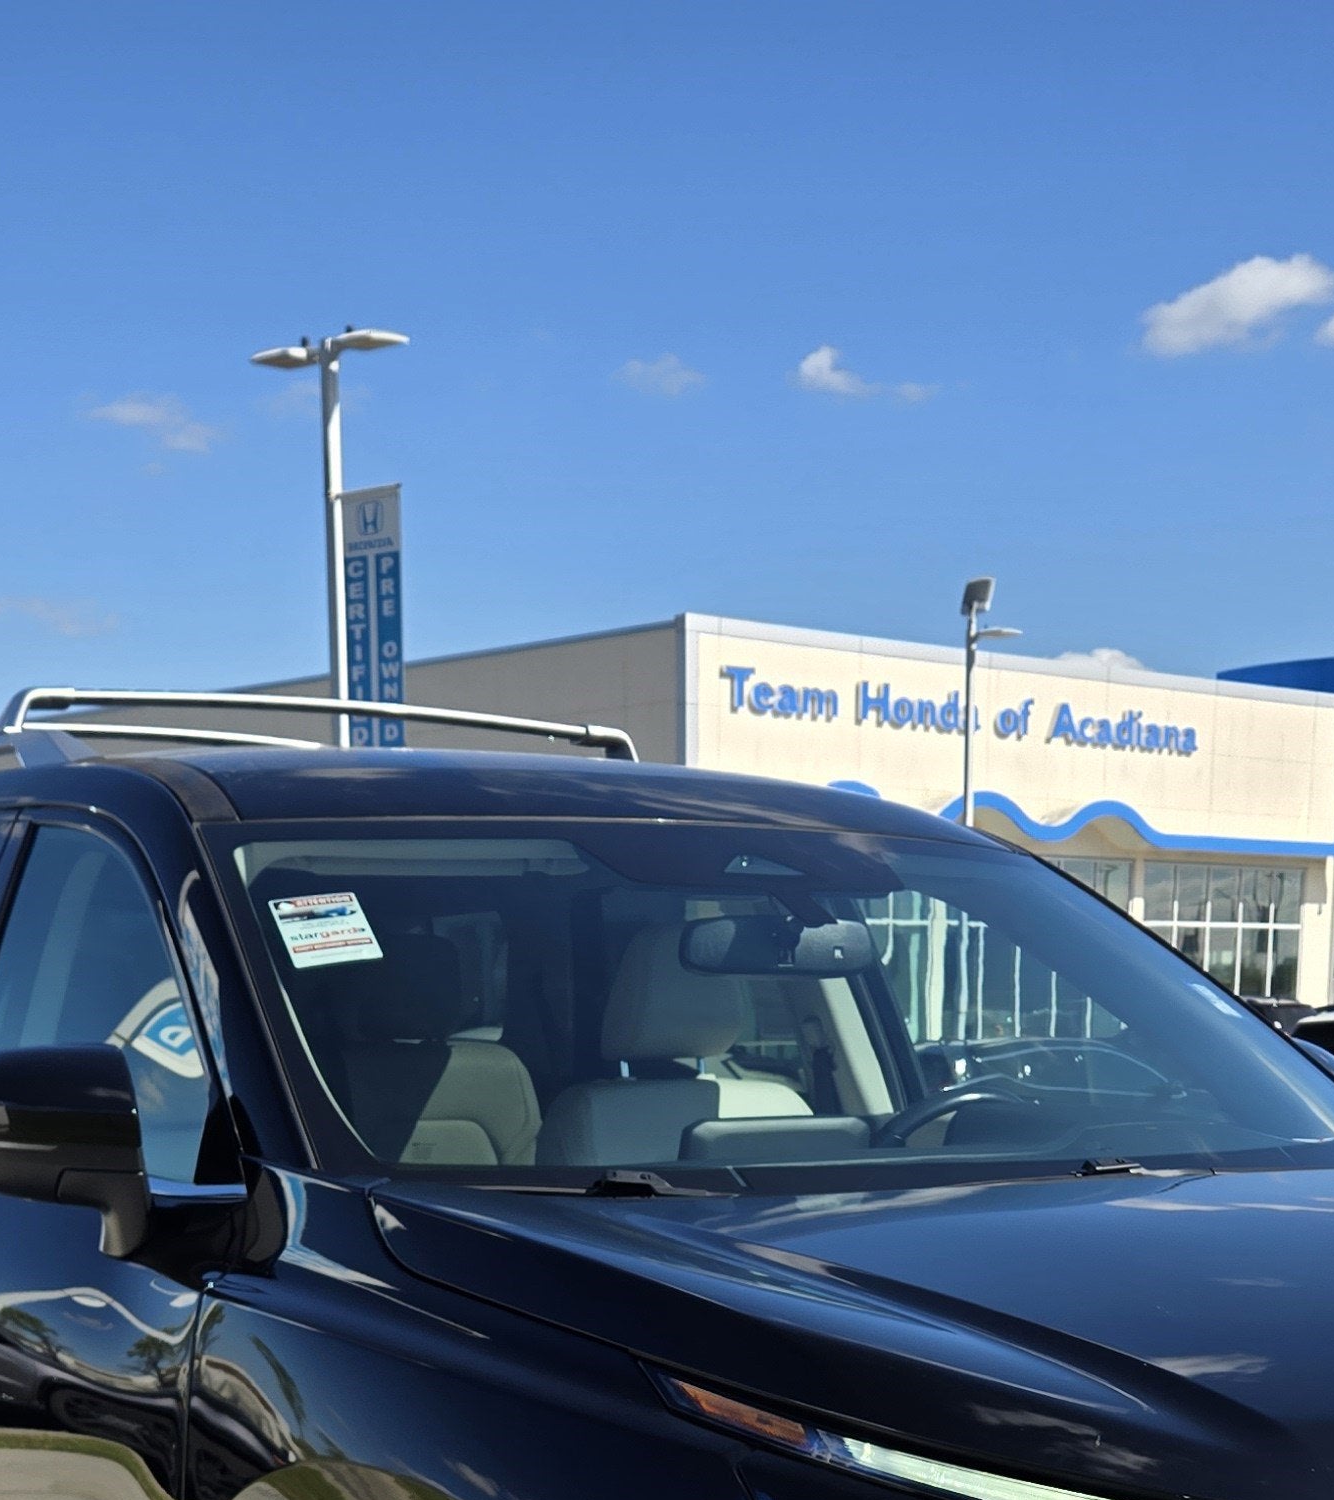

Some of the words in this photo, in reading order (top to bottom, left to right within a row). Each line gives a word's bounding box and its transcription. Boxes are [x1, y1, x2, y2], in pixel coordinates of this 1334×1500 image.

[380, 556, 397, 618] PRE
[347, 560, 369, 746] CERTIFID
[381, 640, 401, 742] OWND
[720, 665, 839, 721] Team
[995, 698, 1035, 740] of
[1046, 702, 1199, 756] Acadiana
